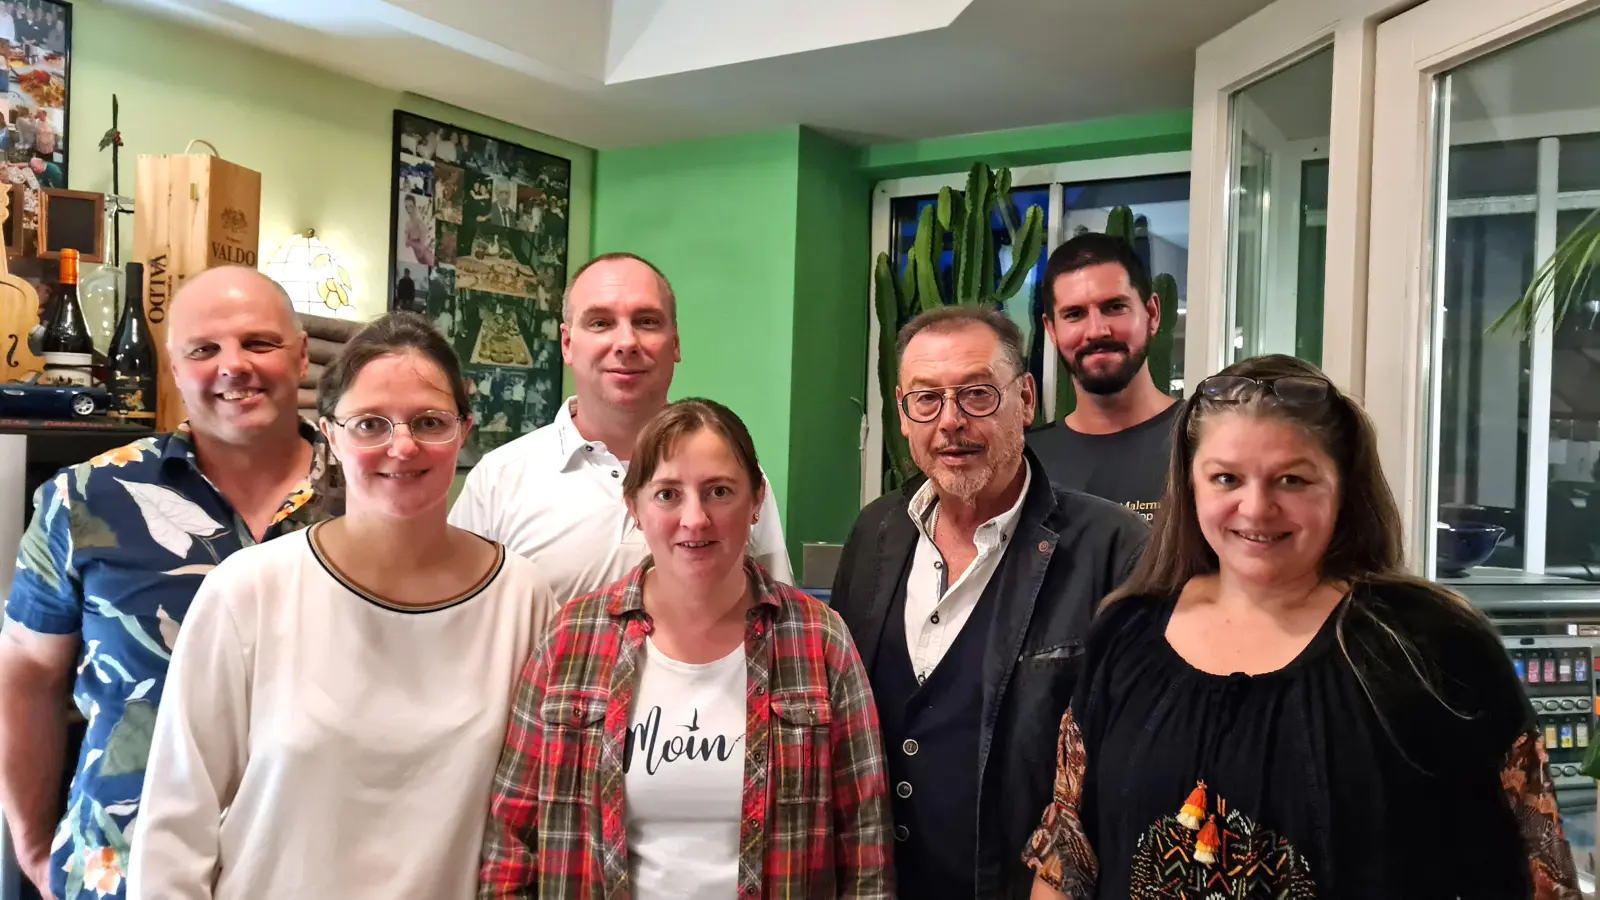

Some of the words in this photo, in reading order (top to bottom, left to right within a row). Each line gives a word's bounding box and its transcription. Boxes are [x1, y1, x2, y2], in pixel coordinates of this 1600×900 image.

[211, 241, 256, 266] VALDO
[148, 254, 166, 324] VALDO
[622, 705, 746, 776] Moin
